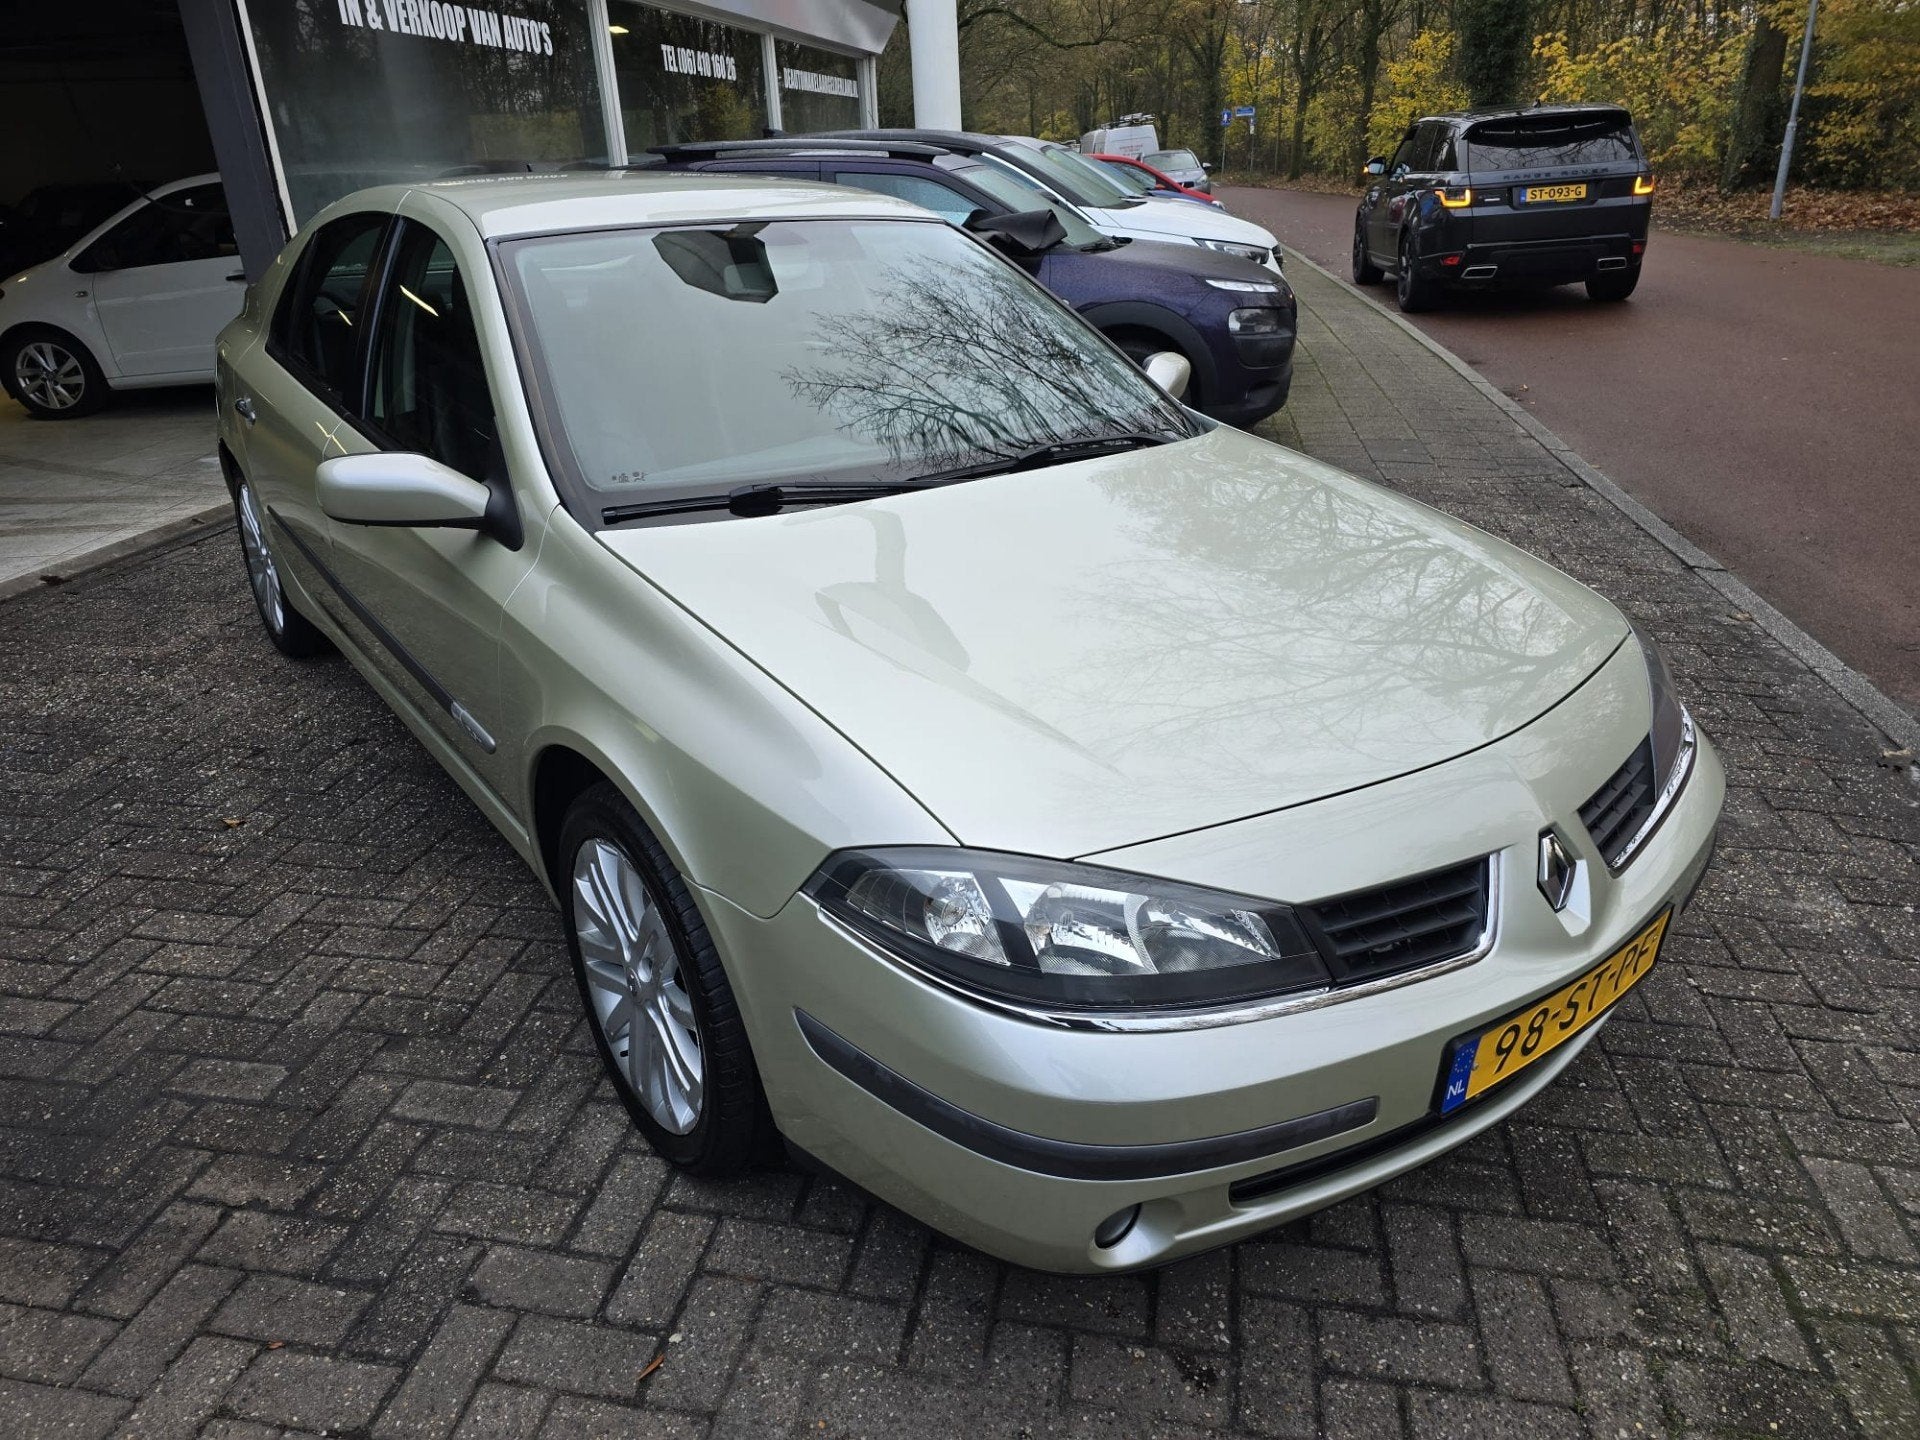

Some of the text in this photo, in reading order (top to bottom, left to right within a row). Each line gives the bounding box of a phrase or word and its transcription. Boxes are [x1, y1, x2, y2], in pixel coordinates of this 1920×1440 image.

[338, 0, 554, 57] IN & VERKOOP VAN AUTO'S
[711, 53, 726, 80] 160
[1530, 186, 1582, 200] ST-093-G
[1494, 924, 1659, 1075] 98-ST-PF
[1446, 1079, 1465, 1100] NL
